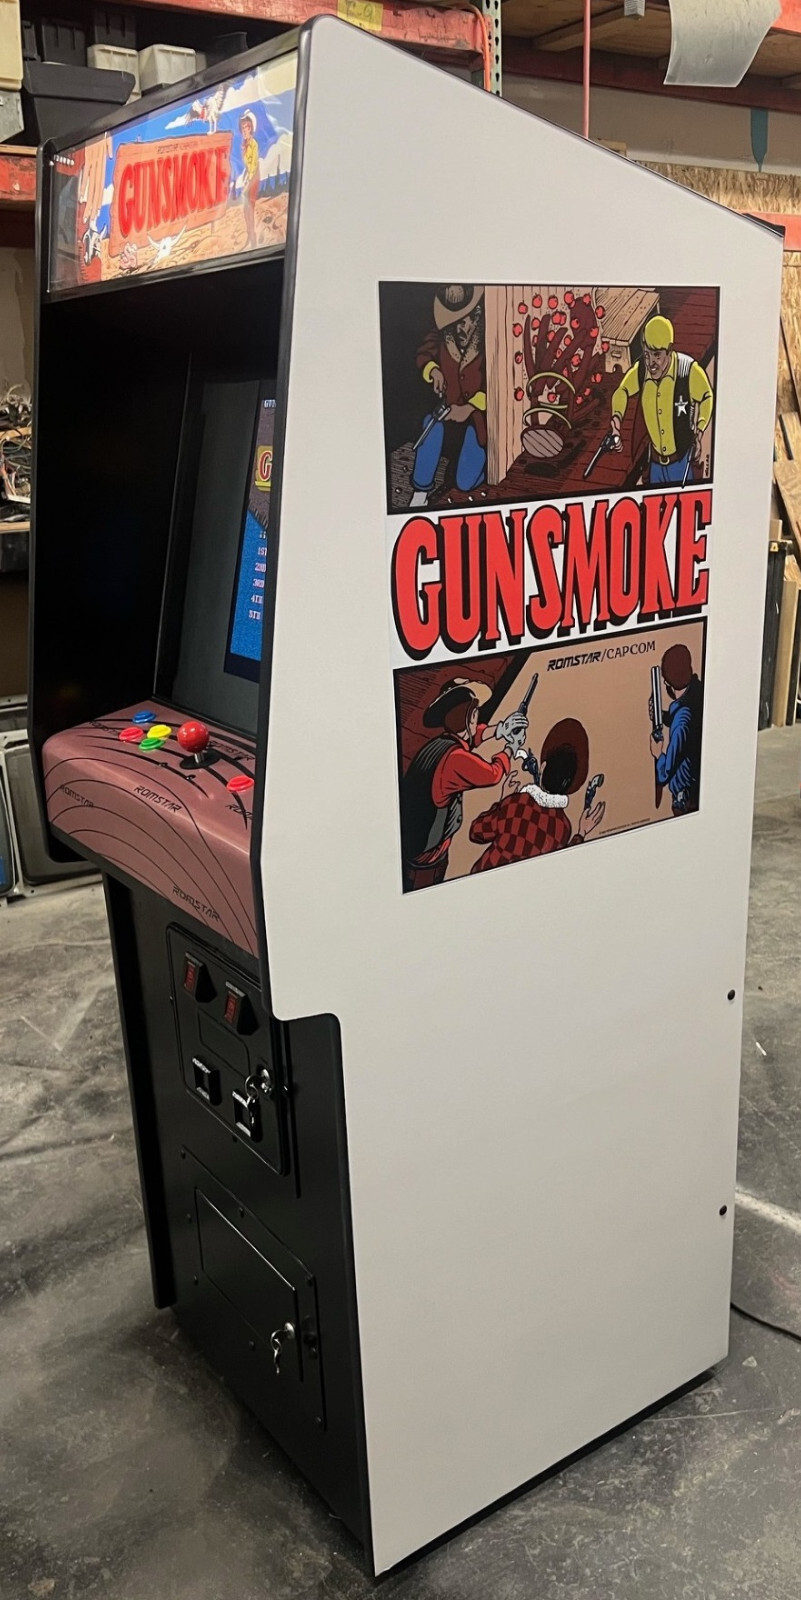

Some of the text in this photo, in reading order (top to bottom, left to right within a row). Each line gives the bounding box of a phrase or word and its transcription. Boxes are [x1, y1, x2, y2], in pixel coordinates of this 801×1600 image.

[118, 146, 229, 238] GUNSMOKE
[391, 489, 713, 660] GUNSMOKE
[547, 641, 656, 671] ROMSTAR/CAPCOM
[133, 785, 183, 813] ROMSTAR
[172, 885, 220, 922] ROMSTAR
